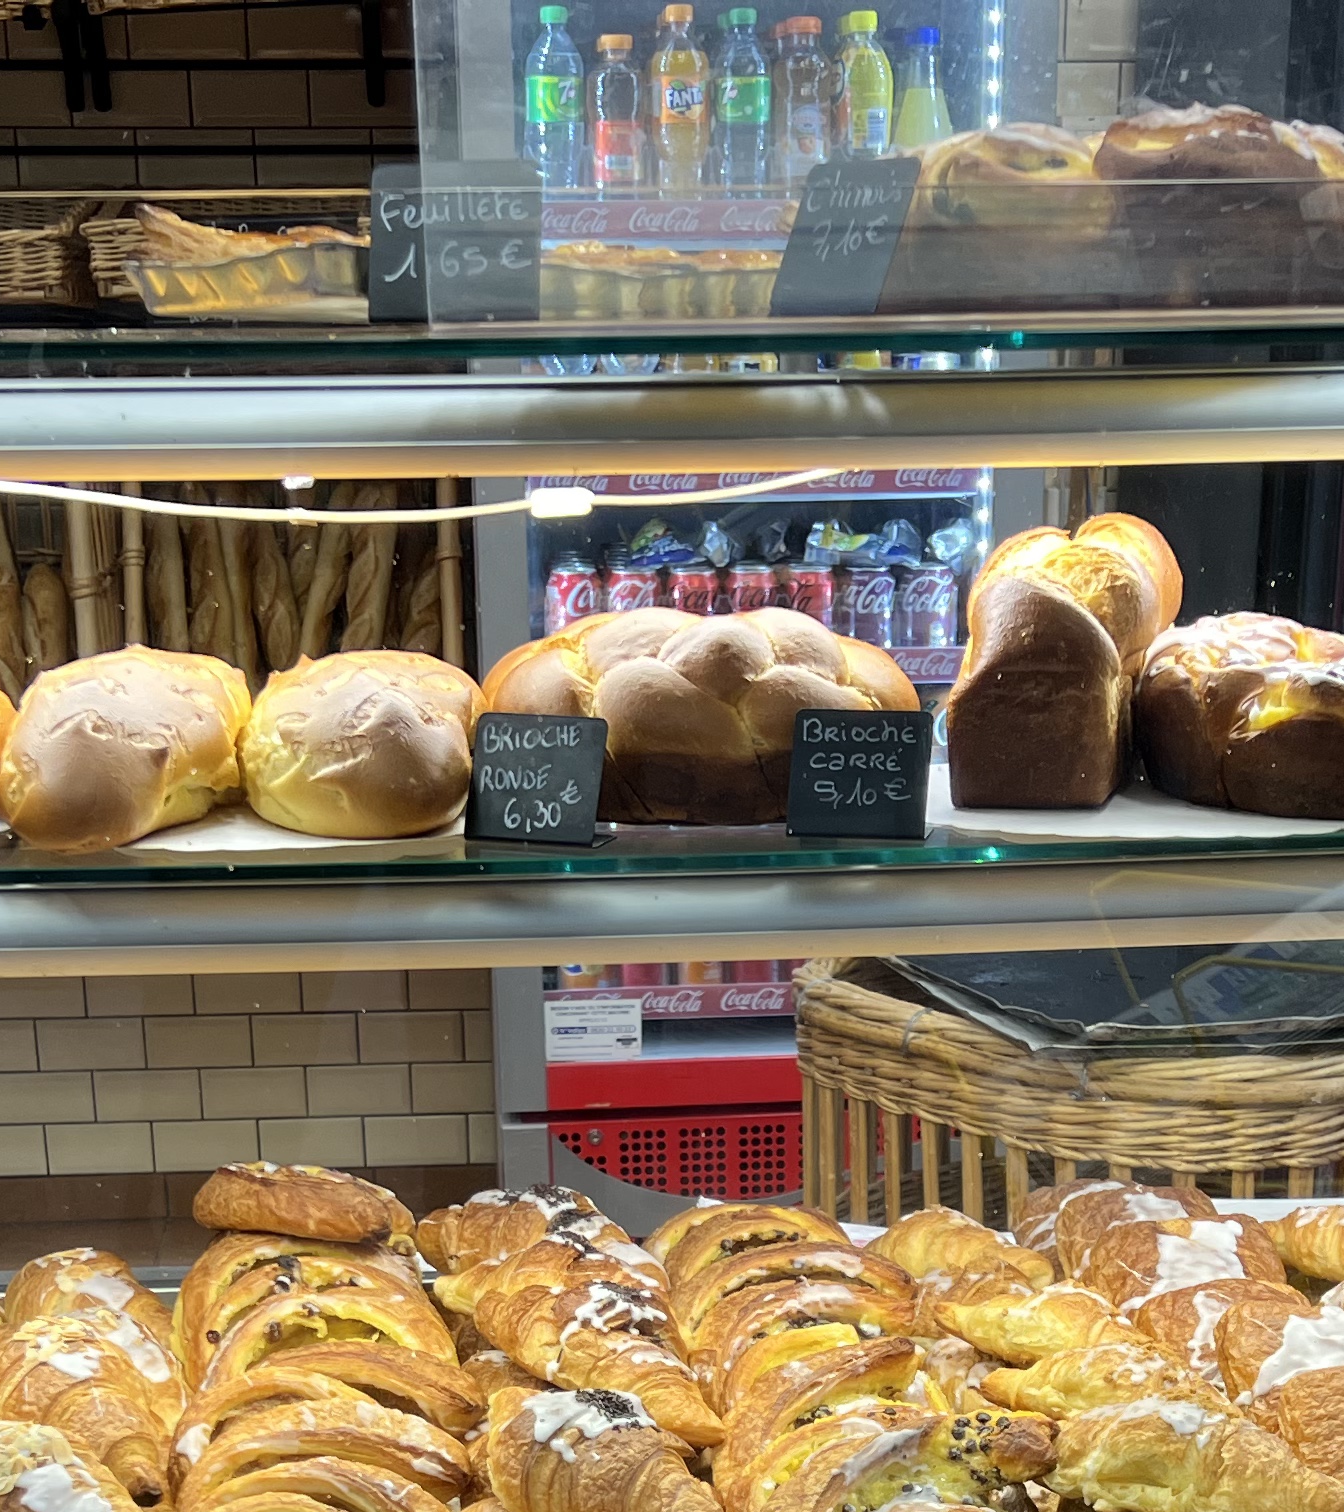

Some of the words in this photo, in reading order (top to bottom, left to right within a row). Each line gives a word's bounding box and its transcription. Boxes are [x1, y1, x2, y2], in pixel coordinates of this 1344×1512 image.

[483, 722, 581, 754] BRIOCHE
[480, 764, 551, 794] RONDE
[720, 988, 787, 1011] Coca-Cola
